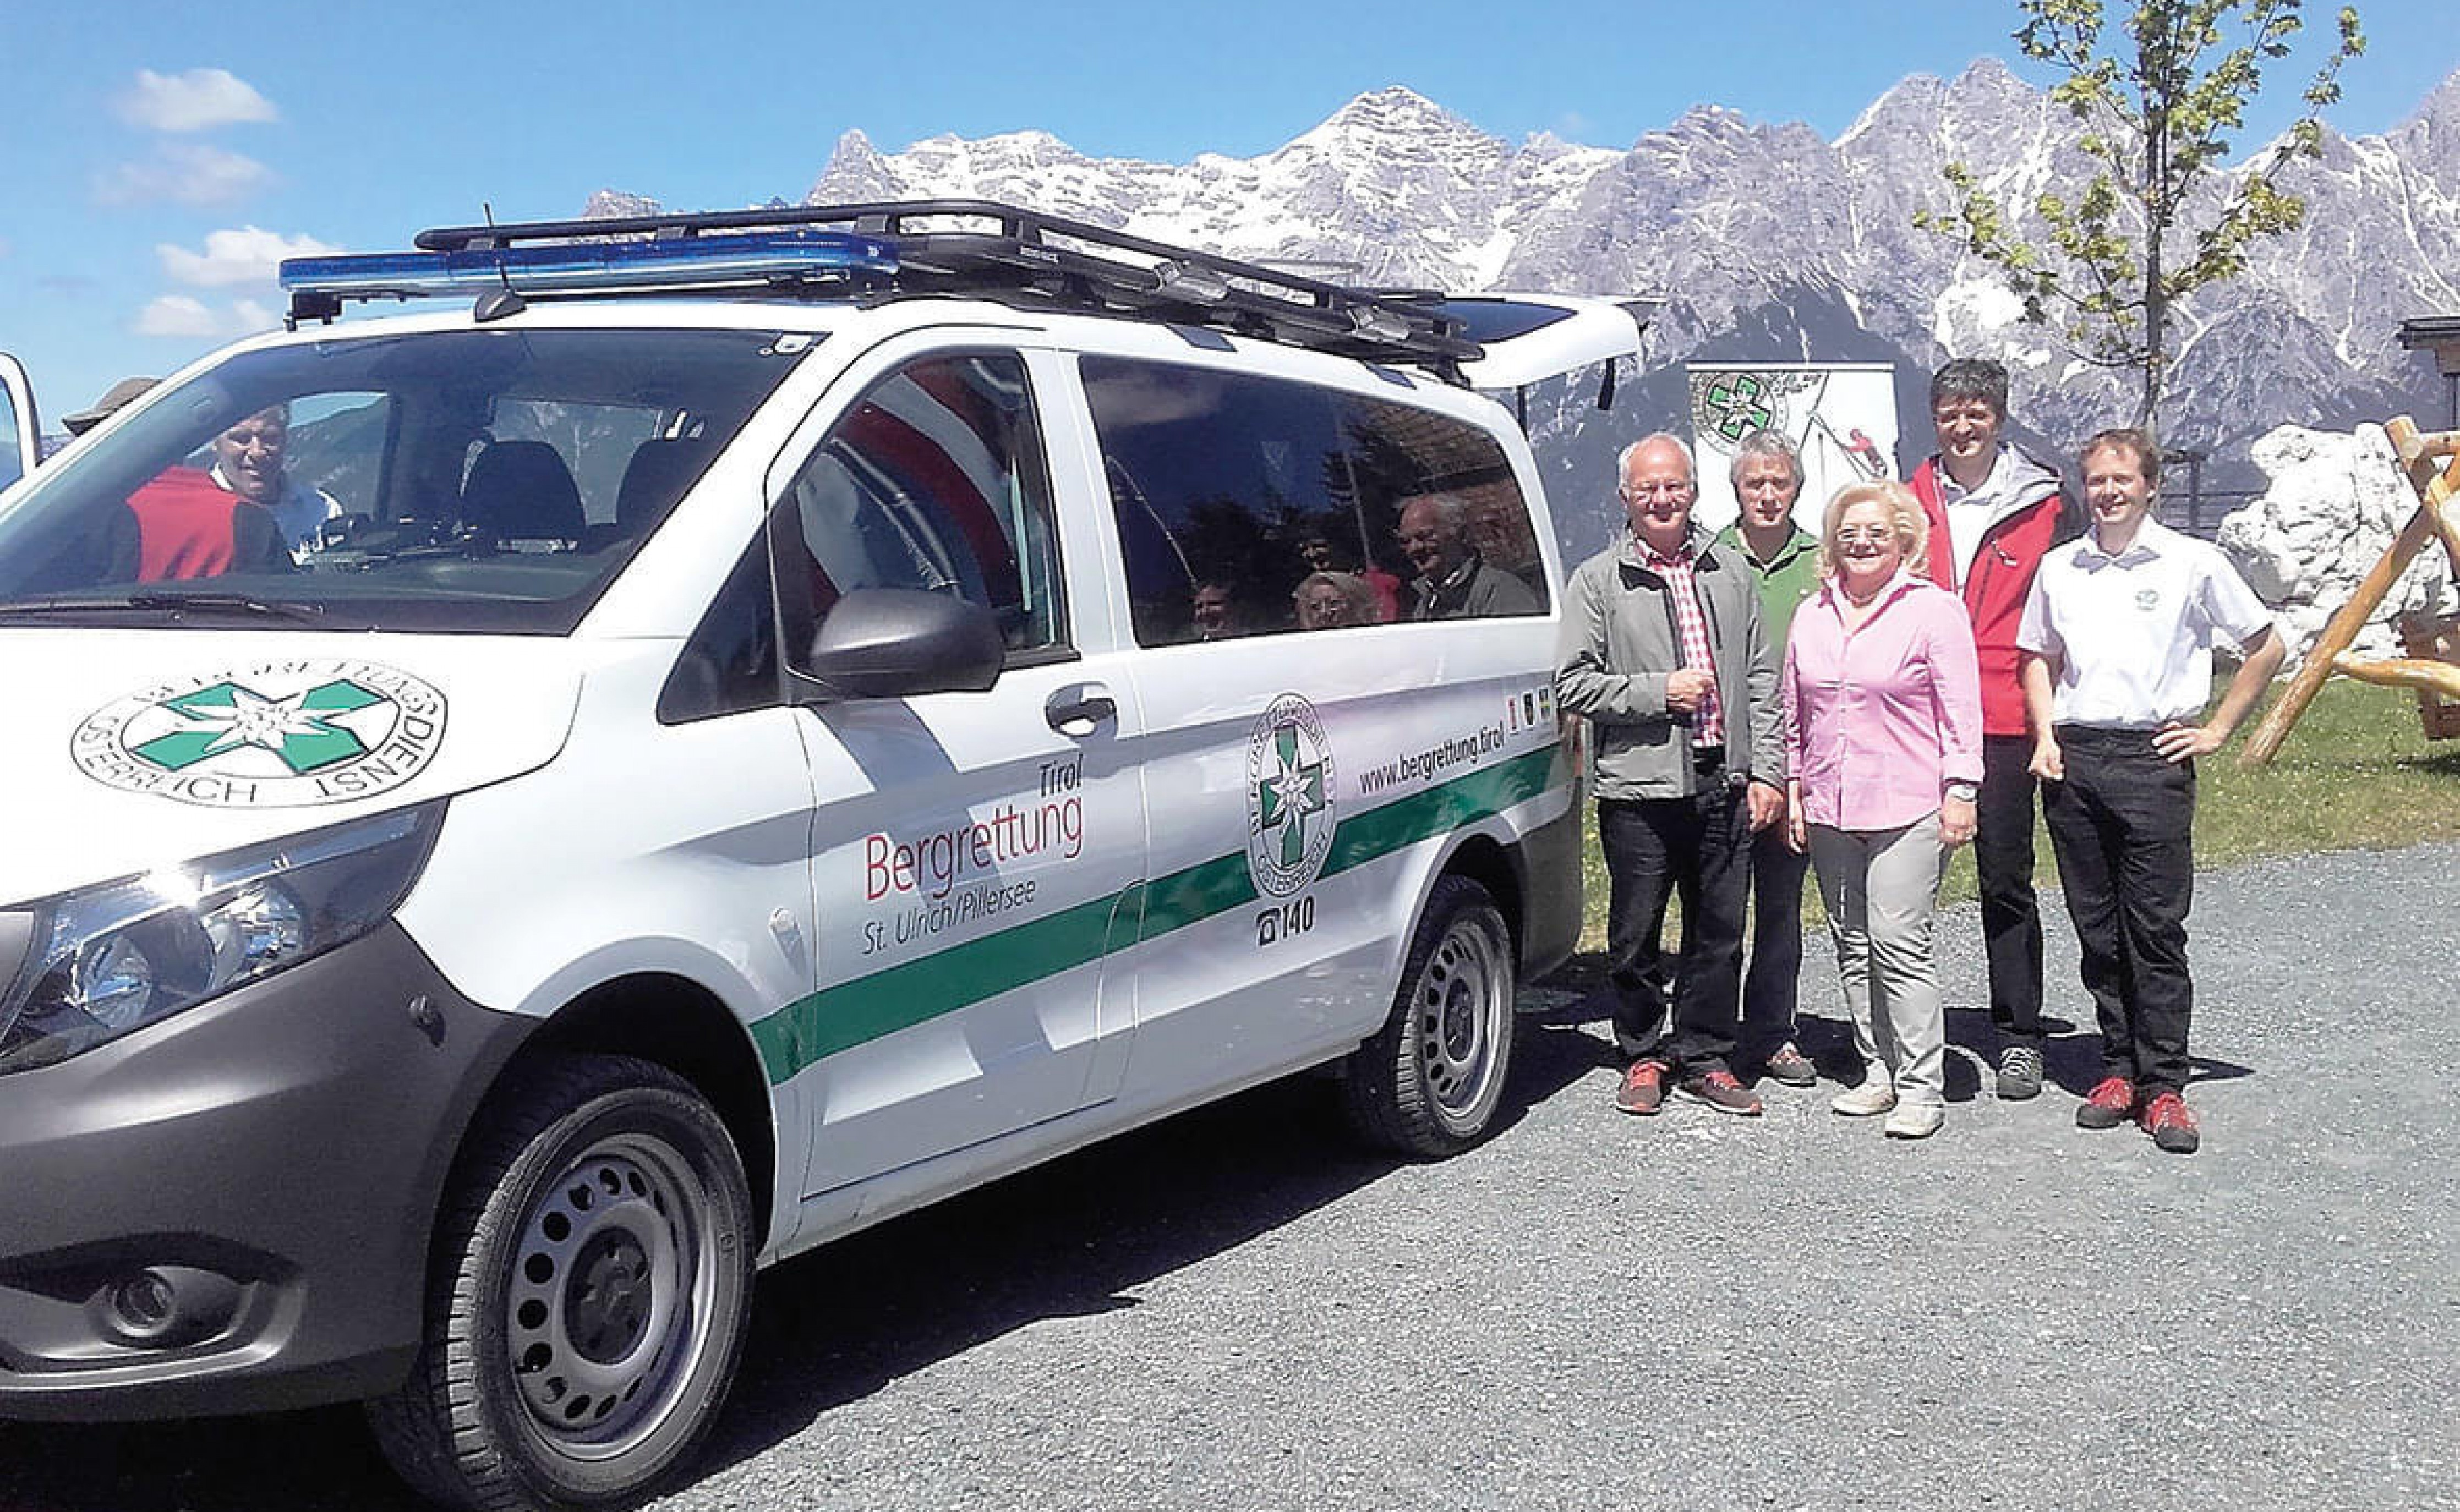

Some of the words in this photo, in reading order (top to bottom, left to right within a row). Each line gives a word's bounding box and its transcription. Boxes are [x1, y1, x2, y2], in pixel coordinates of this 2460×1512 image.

[1040, 752, 1083, 797] Tirol
[1359, 720, 1504, 793] www.bergrettung.tirol
[867, 797, 1082, 901] Bergrettung
[863, 921, 887, 954] St.
[896, 880, 1035, 944] Ulrich/Pillersee
[1283, 896, 1314, 939] 140
